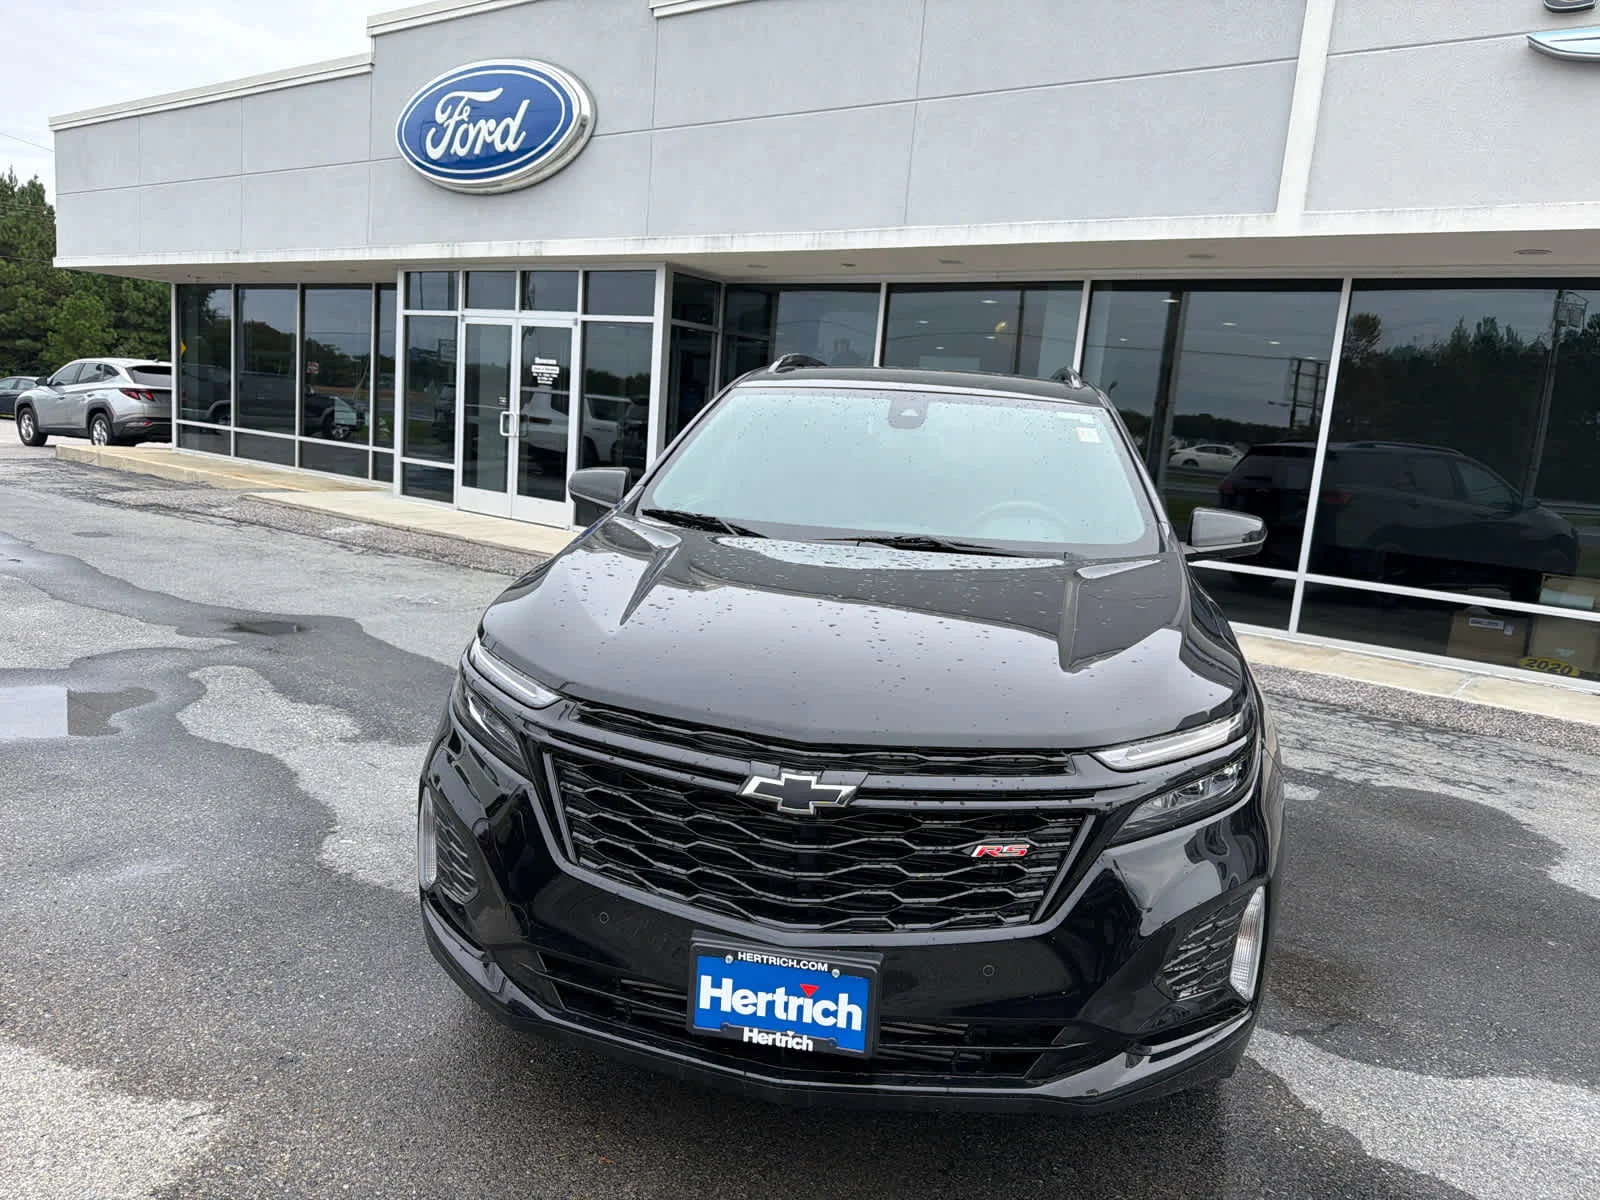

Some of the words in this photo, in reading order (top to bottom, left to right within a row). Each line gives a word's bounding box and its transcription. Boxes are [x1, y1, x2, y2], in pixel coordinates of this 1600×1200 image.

[425, 87, 531, 160] Ford
[1525, 658, 1573, 676] 2020
[971, 844, 1030, 857] RS
[737, 951, 828, 972] HERTRICH.COM
[699, 974, 863, 1031] Hertrich
[743, 1026, 813, 1052] Hertrich
